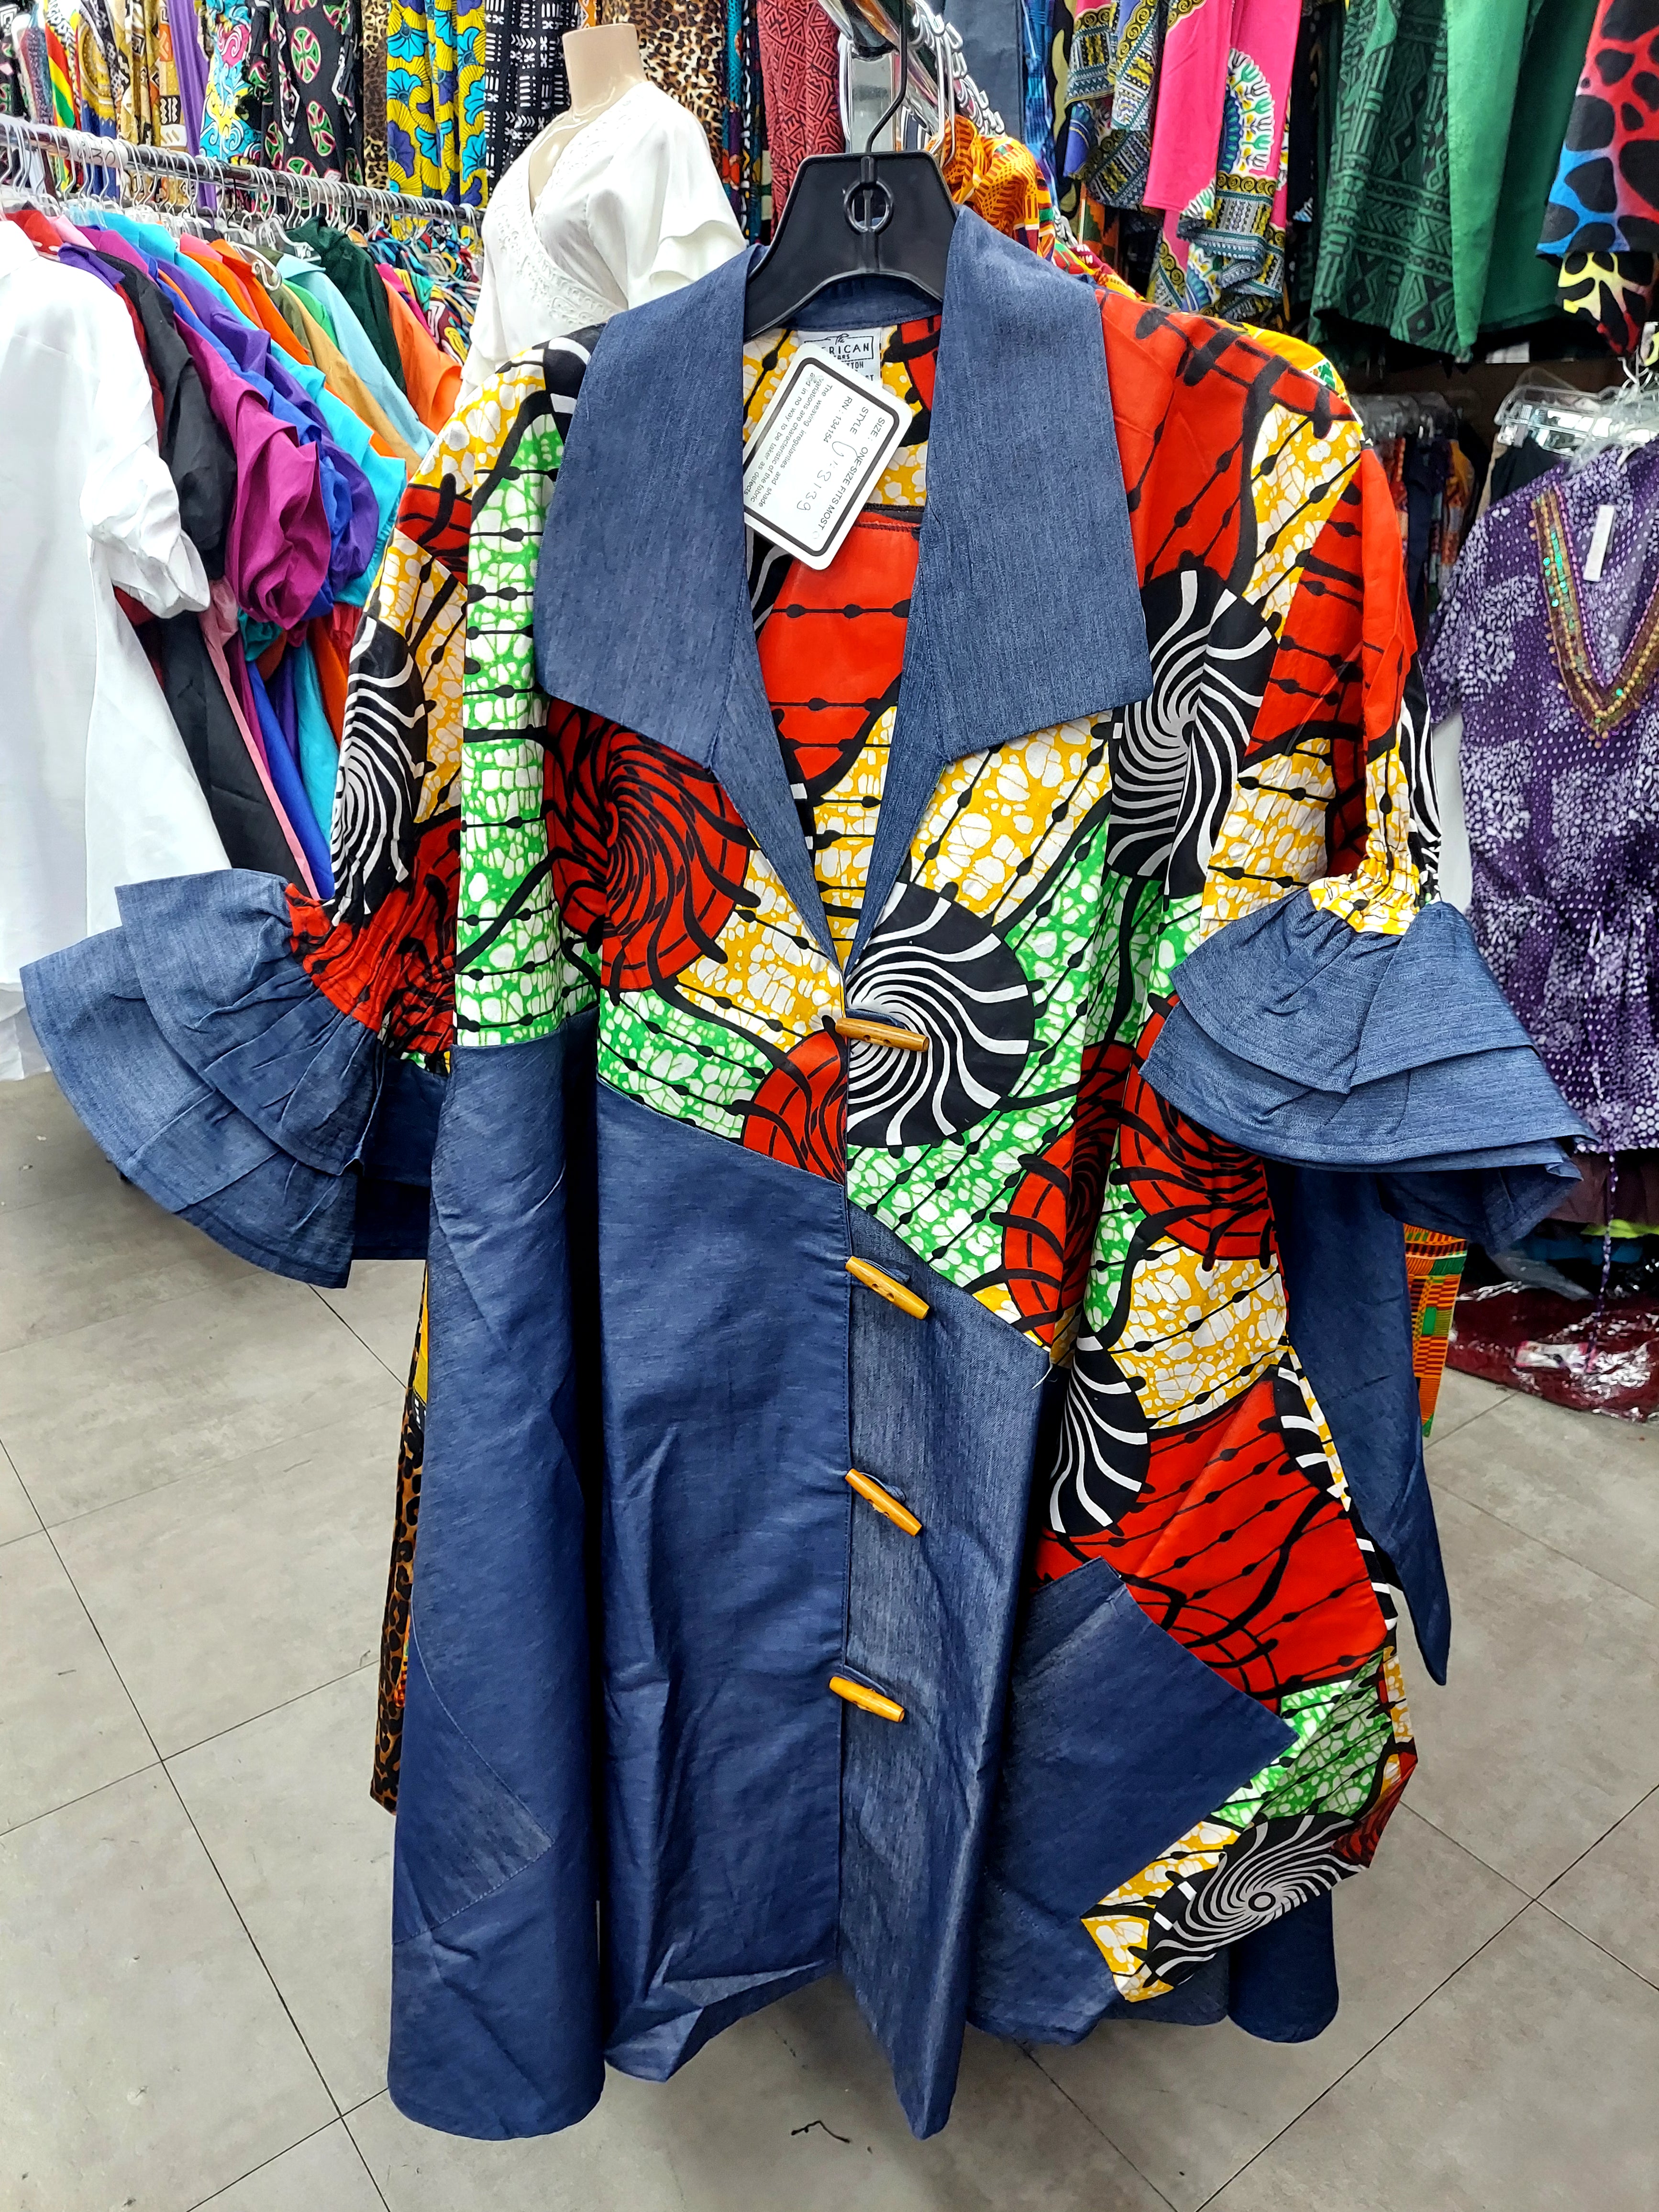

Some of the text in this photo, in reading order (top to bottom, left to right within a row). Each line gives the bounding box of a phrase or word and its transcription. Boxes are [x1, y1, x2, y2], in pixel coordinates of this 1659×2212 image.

[822, 343, 869, 354] RICAN
[795, 396, 802, 406] no
[841, 396, 853, 410] RN
[785, 408, 796, 422] way
[849, 407, 869, 435] STYLE
[774, 431, 784, 441] be
[822, 416, 841, 443] 134154
[870, 417, 885, 438] SIZE
[750, 378, 824, 502] variations are characteristic of the fabric
[758, 384, 833, 507] The weaving irregularities and shade
[758, 461, 765, 470] as
[742, 472, 760, 495] defects
[831, 485, 846, 505] FITS
[818, 504, 835, 531] MOST
